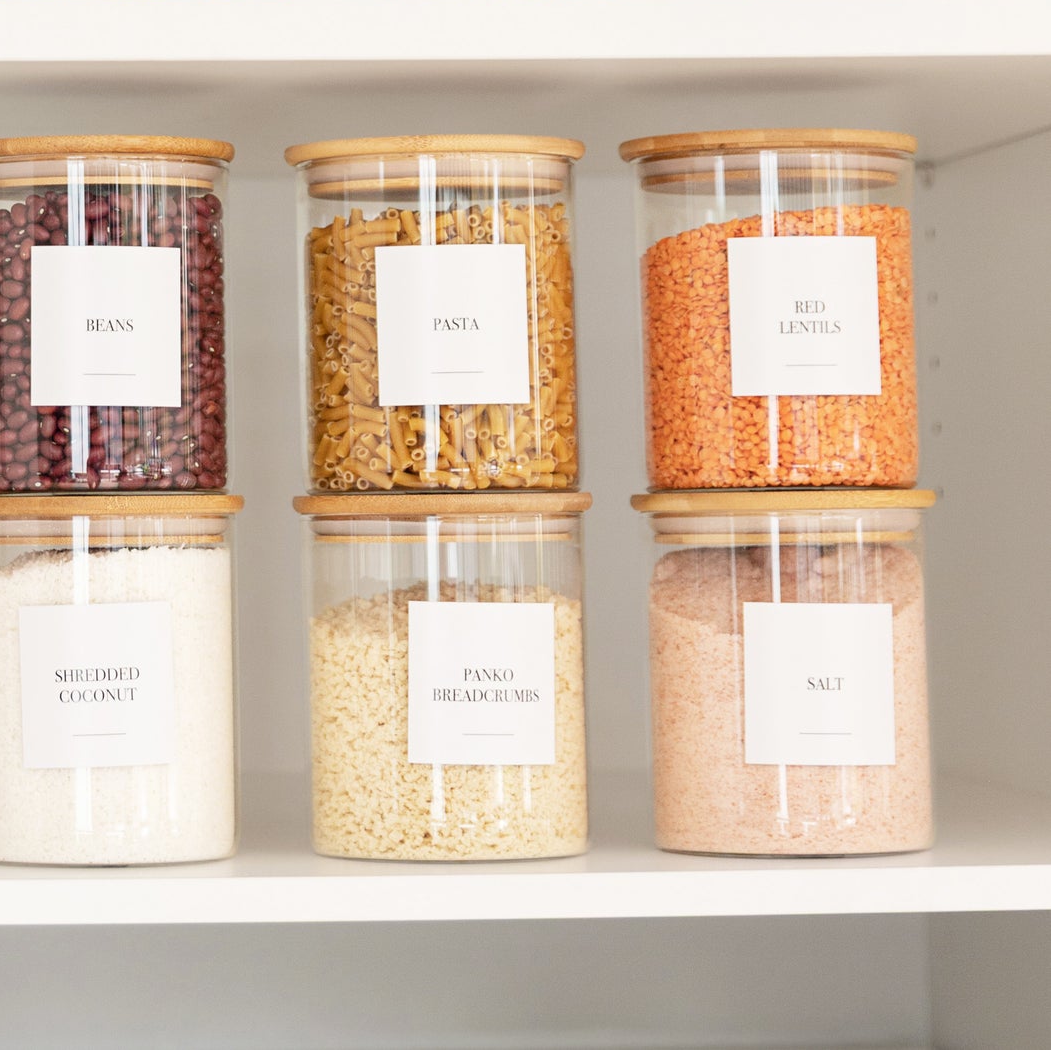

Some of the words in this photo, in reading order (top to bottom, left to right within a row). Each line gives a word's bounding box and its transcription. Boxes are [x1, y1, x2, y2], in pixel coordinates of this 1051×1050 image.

[794, 300, 826, 314] RED
[86, 318, 134, 333] BEANS
[433, 317, 480, 332] PASTA
[779, 320, 842, 335] LENTILS
[54, 666, 140, 683] SHREDDED
[463, 667, 515, 682] PANKO
[806, 676, 846, 691] SALT
[59, 687, 138, 704] COCONUT
[432, 688, 540, 703] BREADCRUMBS
